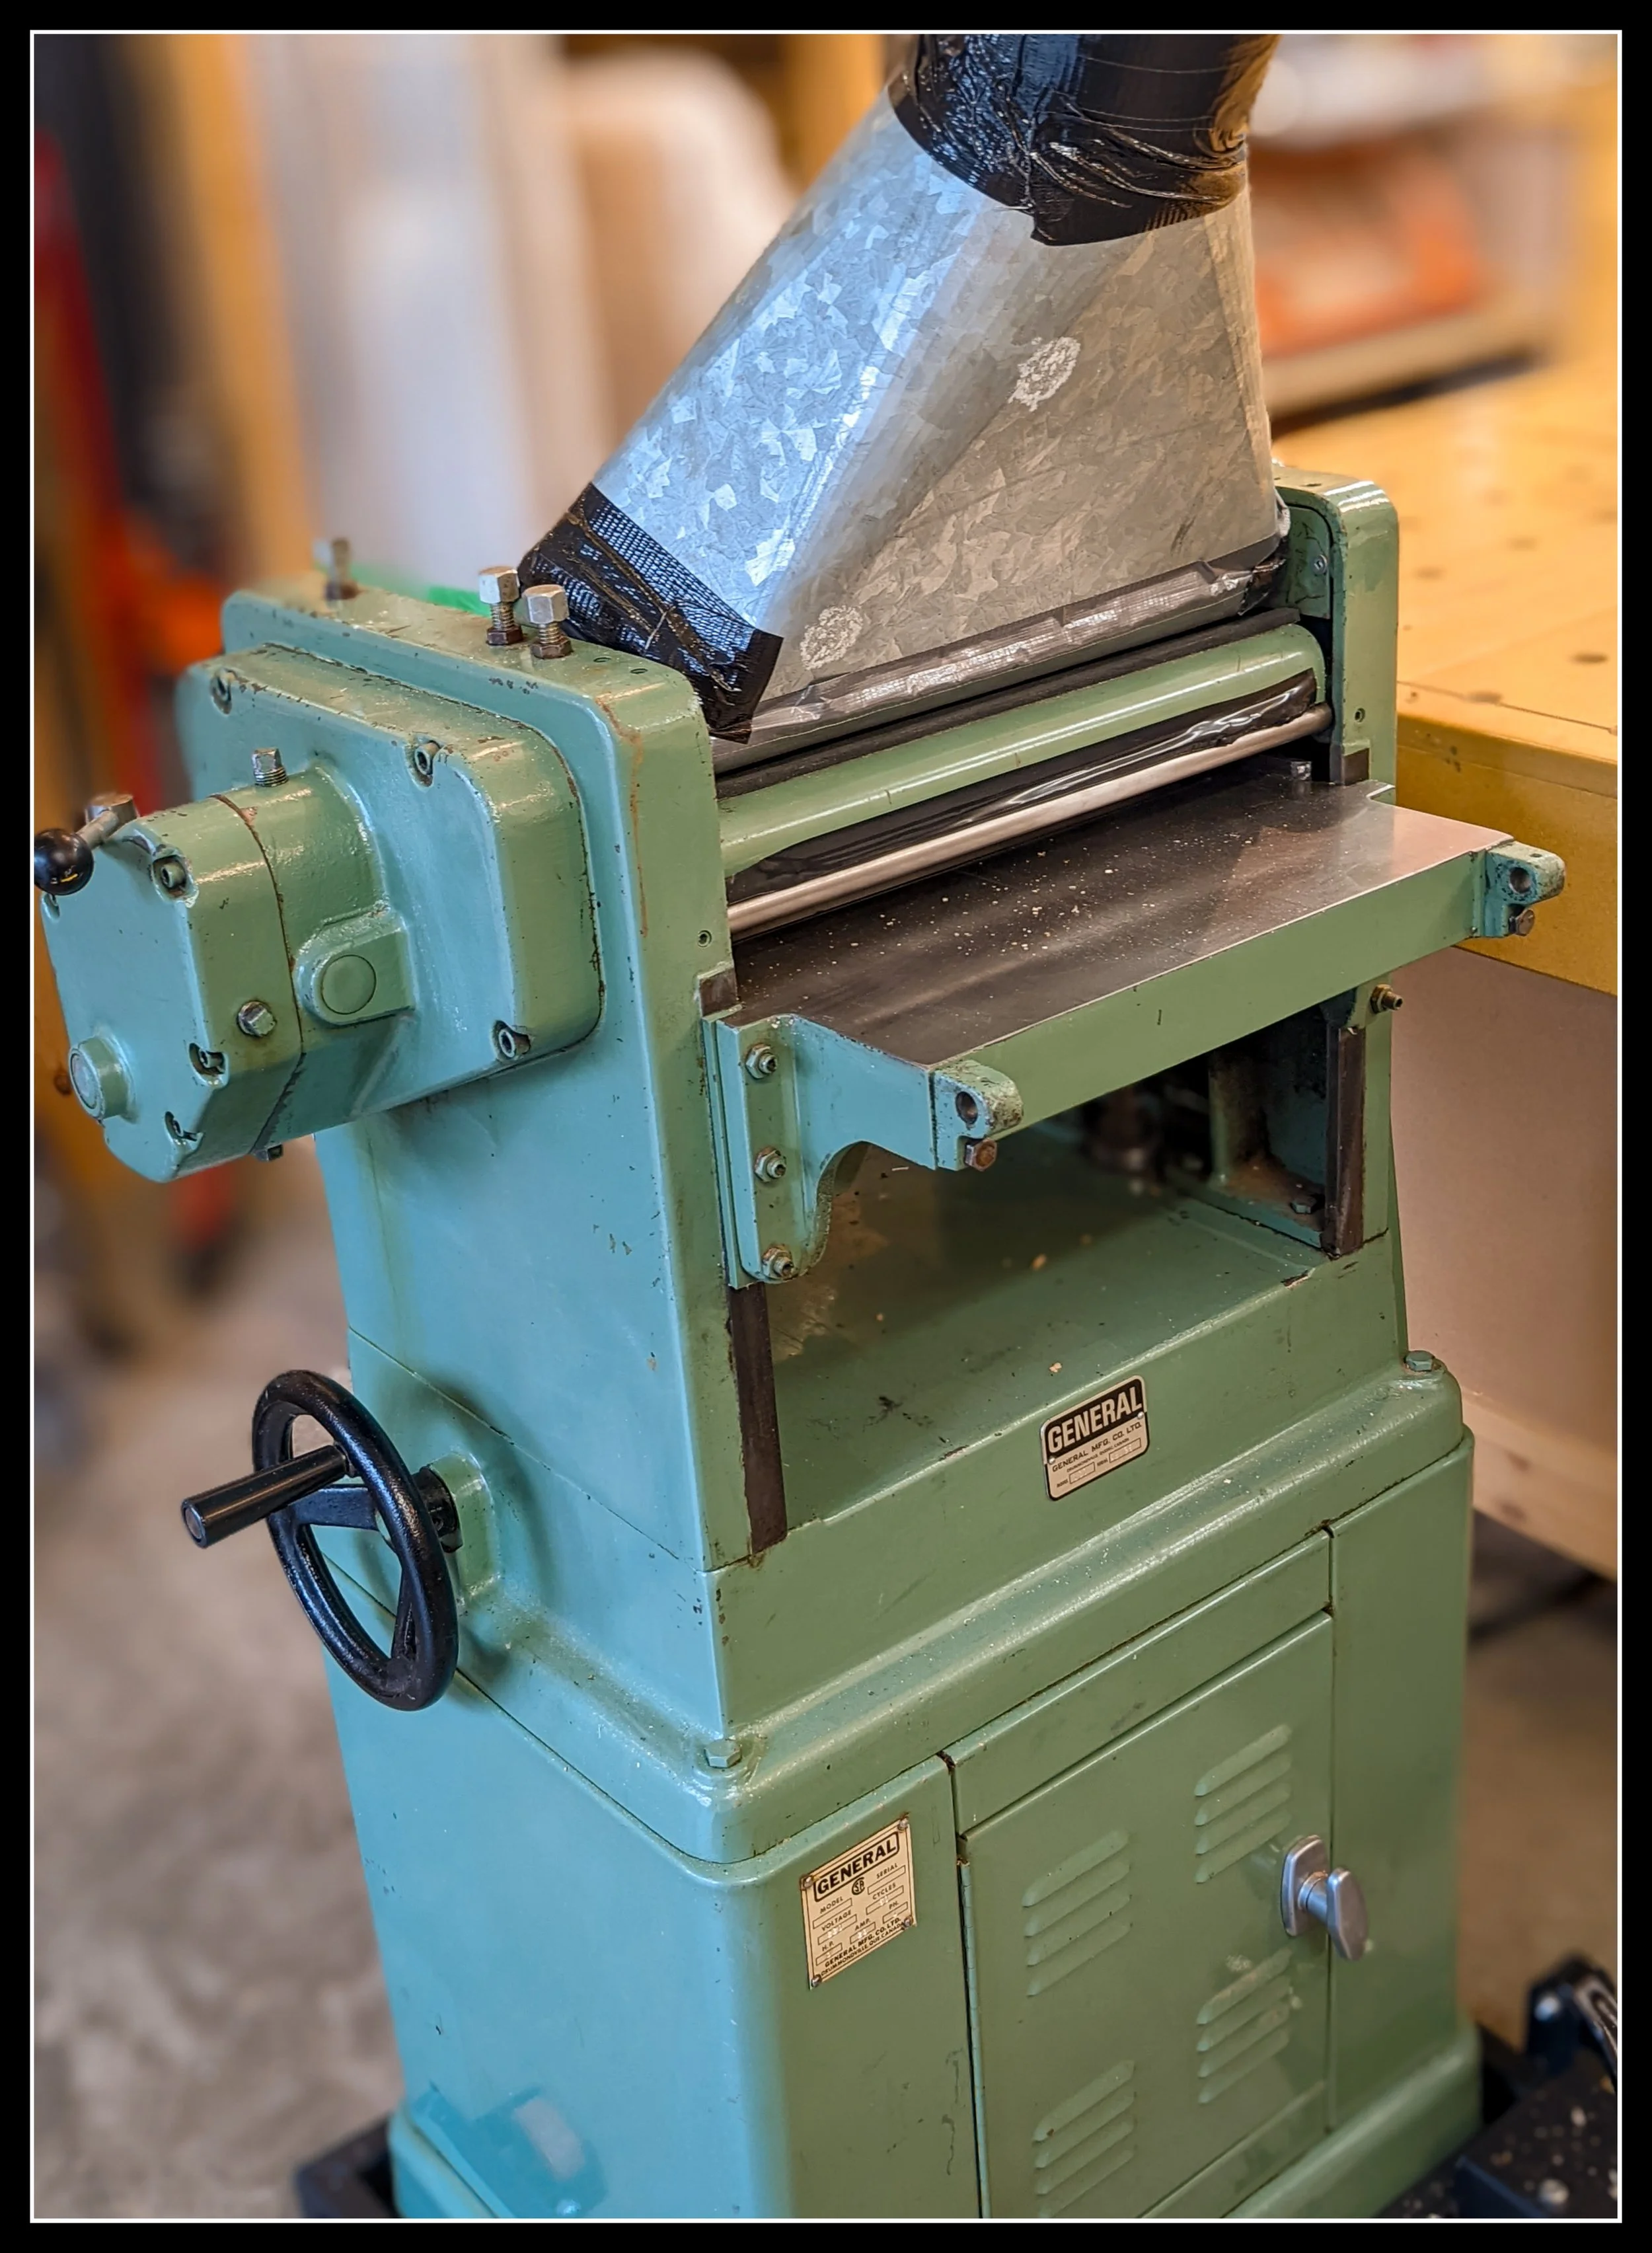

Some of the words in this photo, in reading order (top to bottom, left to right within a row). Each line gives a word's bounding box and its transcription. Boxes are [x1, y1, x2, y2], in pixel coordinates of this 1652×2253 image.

[1047, 1386, 1143, 1453] GENERAL
[1052, 1451, 1089, 1472] GENERAL
[1092, 1438, 1110, 1452] MFG.
[817, 1839, 896, 1894] GENERAL
[876, 1863, 898, 1879] SERIAL
[819, 1895, 844, 1914] MODEL
[872, 1882, 896, 1900] CYCLES
[821, 1909, 852, 1931] VOLTAGE
[825, 1945, 857, 1968] GENERAL
[858, 1934, 875, 1947] MFG.
